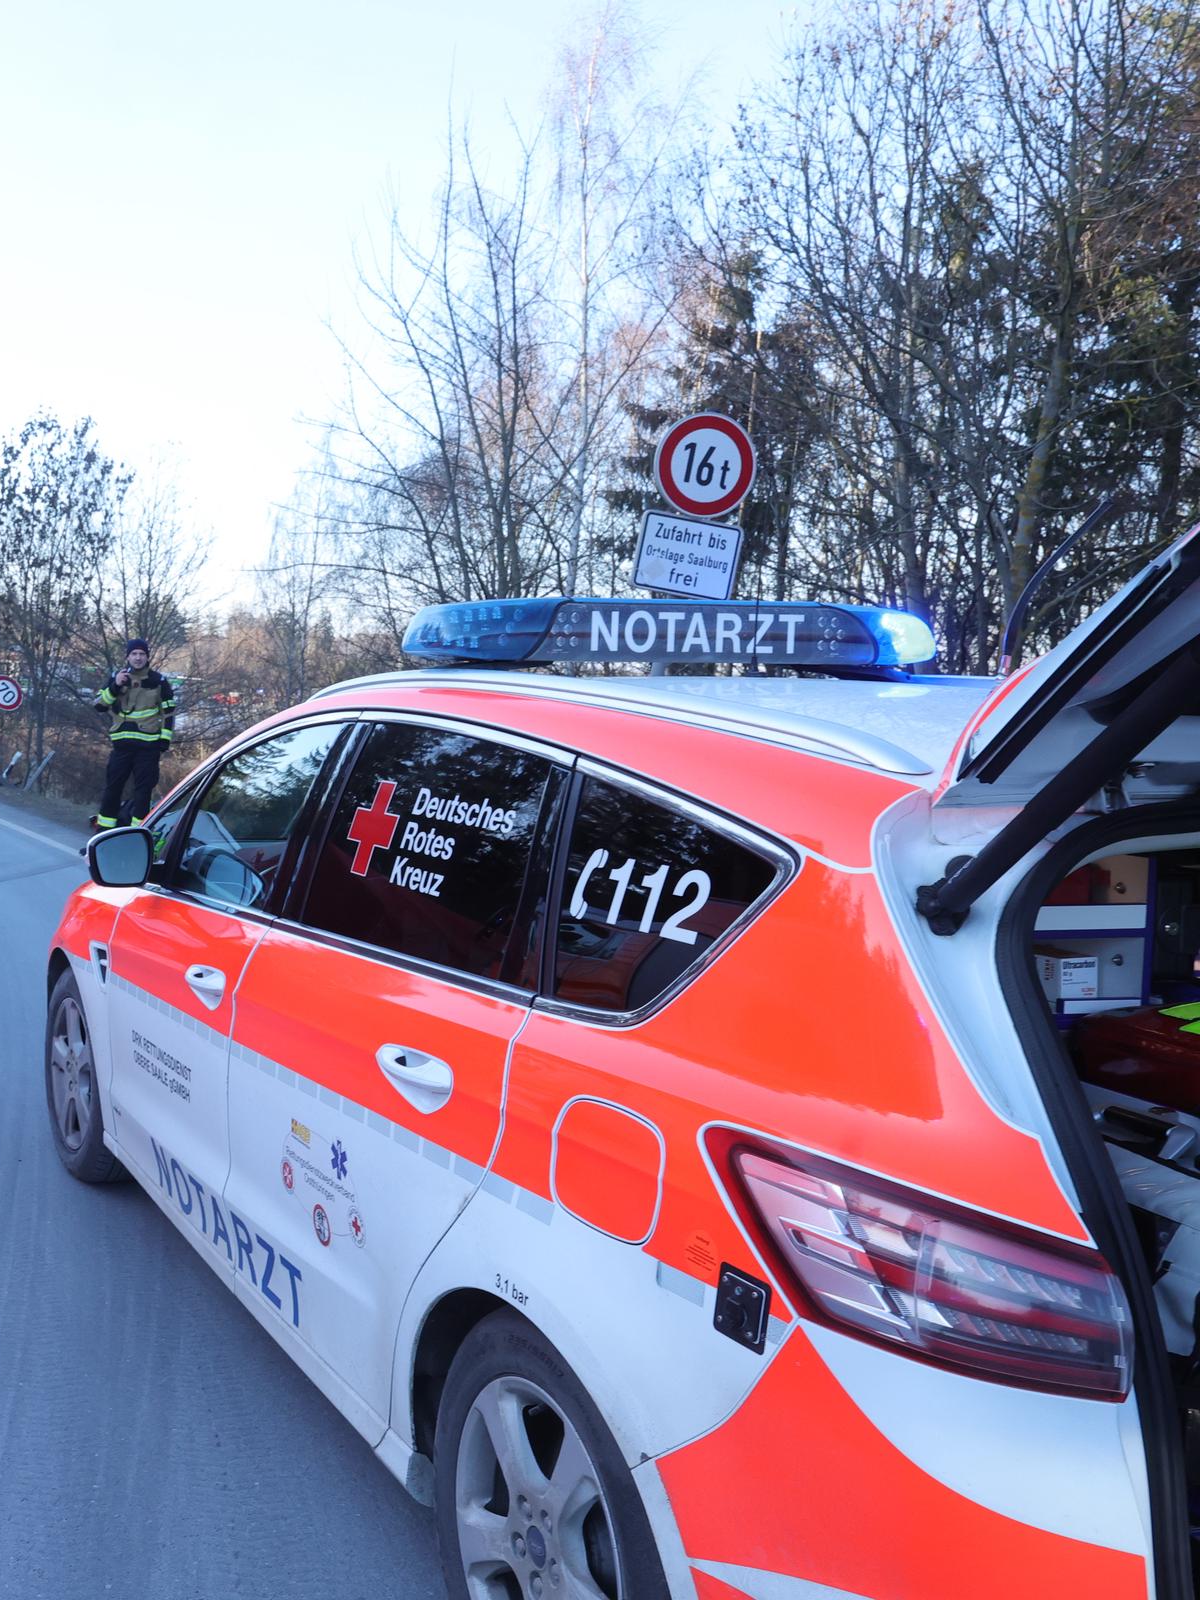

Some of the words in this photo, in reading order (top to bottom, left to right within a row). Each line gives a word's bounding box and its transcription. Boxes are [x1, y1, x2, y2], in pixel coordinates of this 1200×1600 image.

[655, 522, 703, 546] Zufahrt
[708, 533, 727, 550] bis
[669, 568, 699, 588] frei
[687, 554, 728, 574] Saalburg
[590, 610, 805, 655] NOTARZT
[412, 787, 516, 835] Deutsches
[400, 821, 456, 860] Rotes
[388, 856, 445, 898] Kreuz
[606, 858, 712, 945] 112
[131, 1029, 143, 1048] DRK
[142, 1037, 192, 1083] RETTUNGSDIENST
[133, 1049, 151, 1073] OBERE
[150, 1136, 303, 1328] NOTARZT
[495, 1273, 509, 1294] 3,1
[512, 1283, 529, 1306] bar
